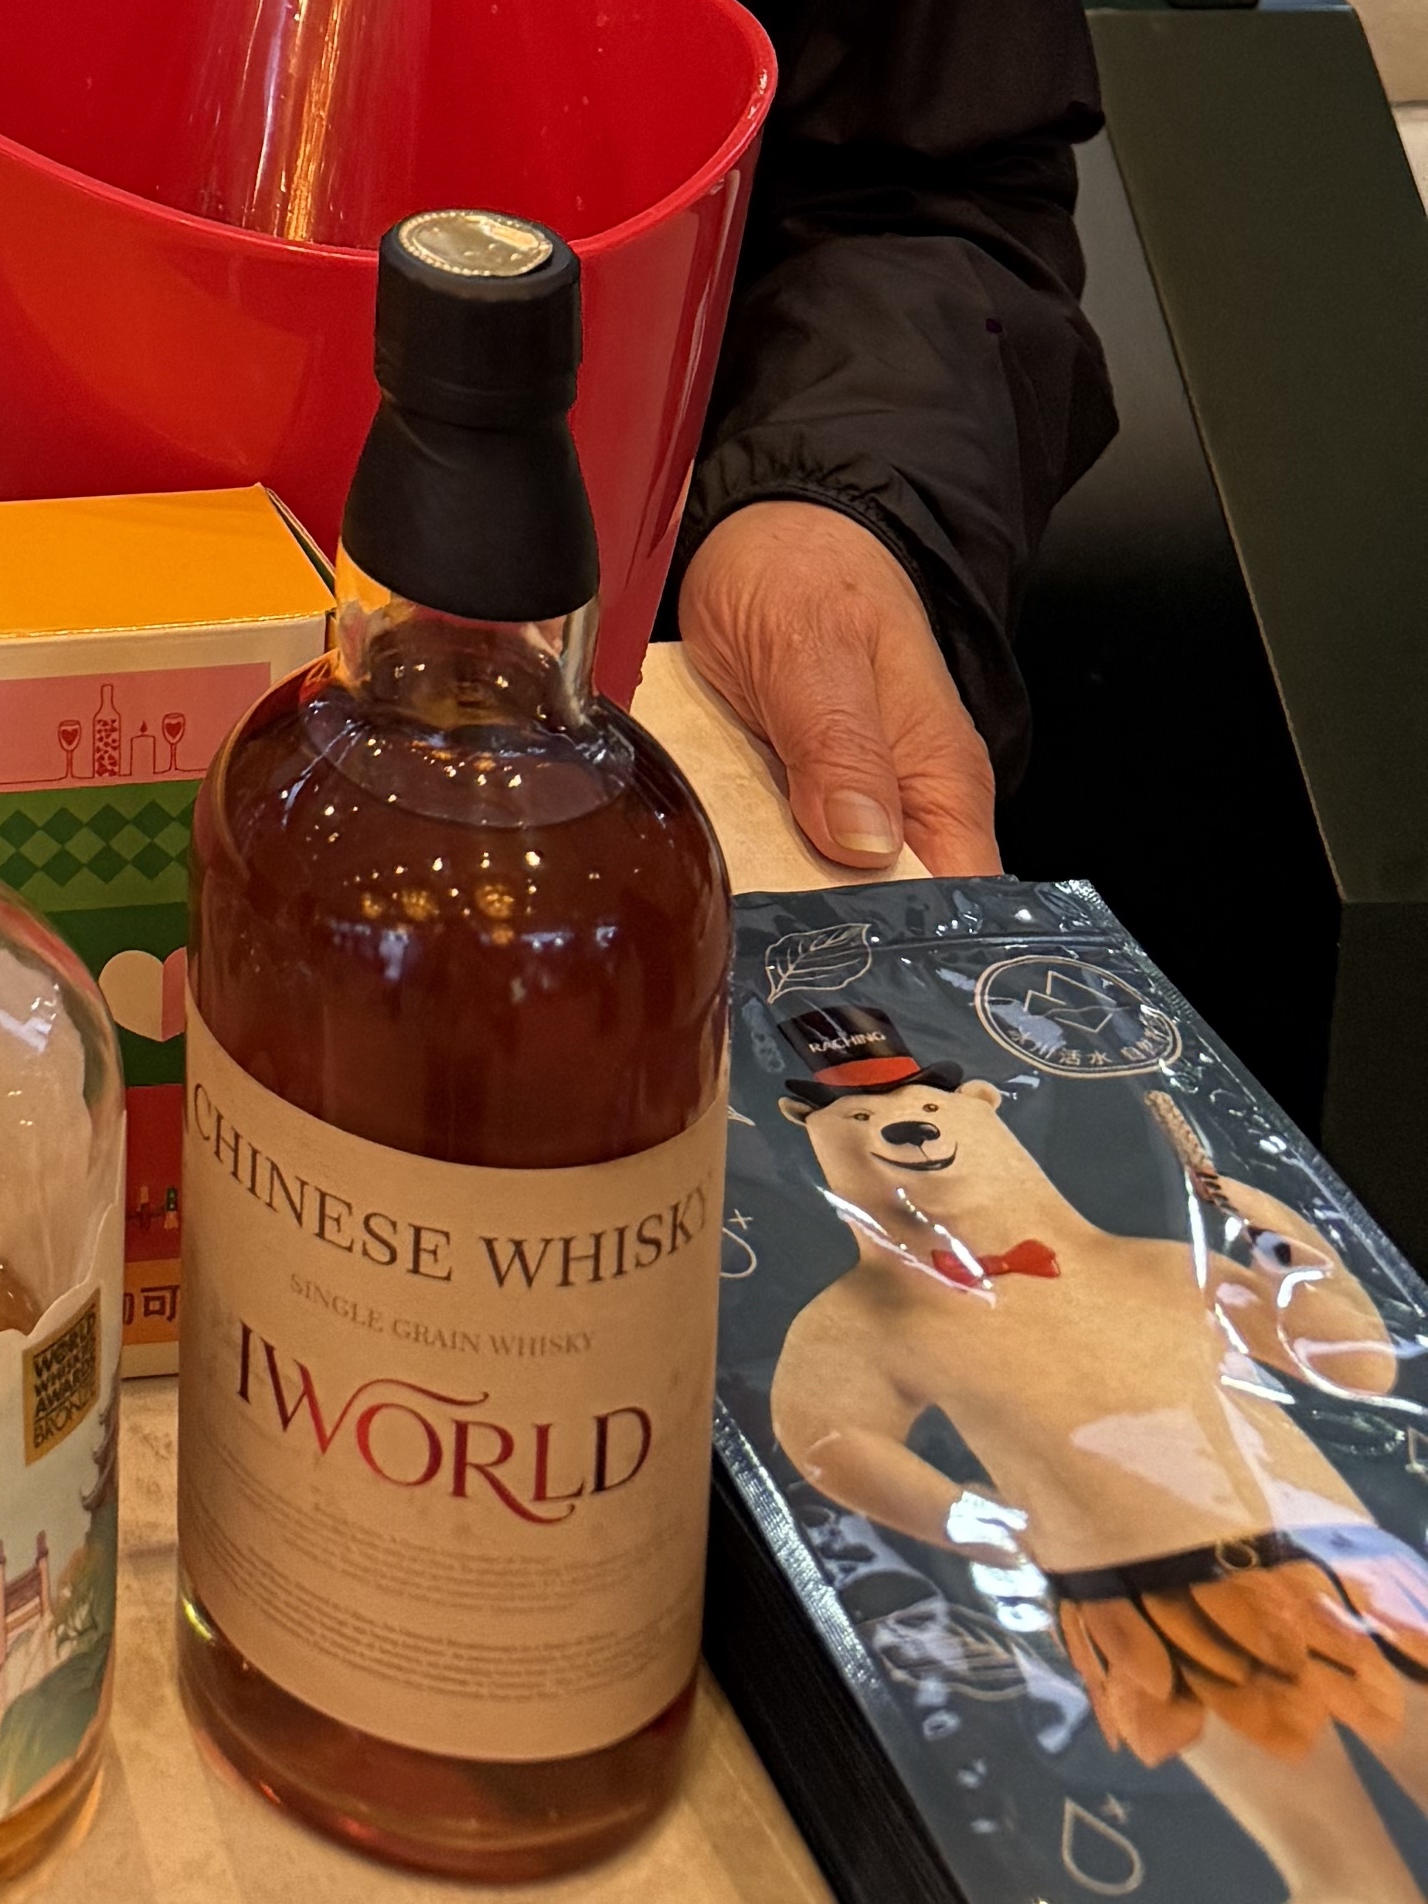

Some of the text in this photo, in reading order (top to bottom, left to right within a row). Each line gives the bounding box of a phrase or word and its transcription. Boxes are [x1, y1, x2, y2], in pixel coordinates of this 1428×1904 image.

[808, 1029, 887, 1055] RACHING
[193, 1082, 453, 1284] CHINESE
[290, 1272, 596, 1359] SINGLE GRAIN WHISKY
[237, 1318, 654, 1526] IWORLD
